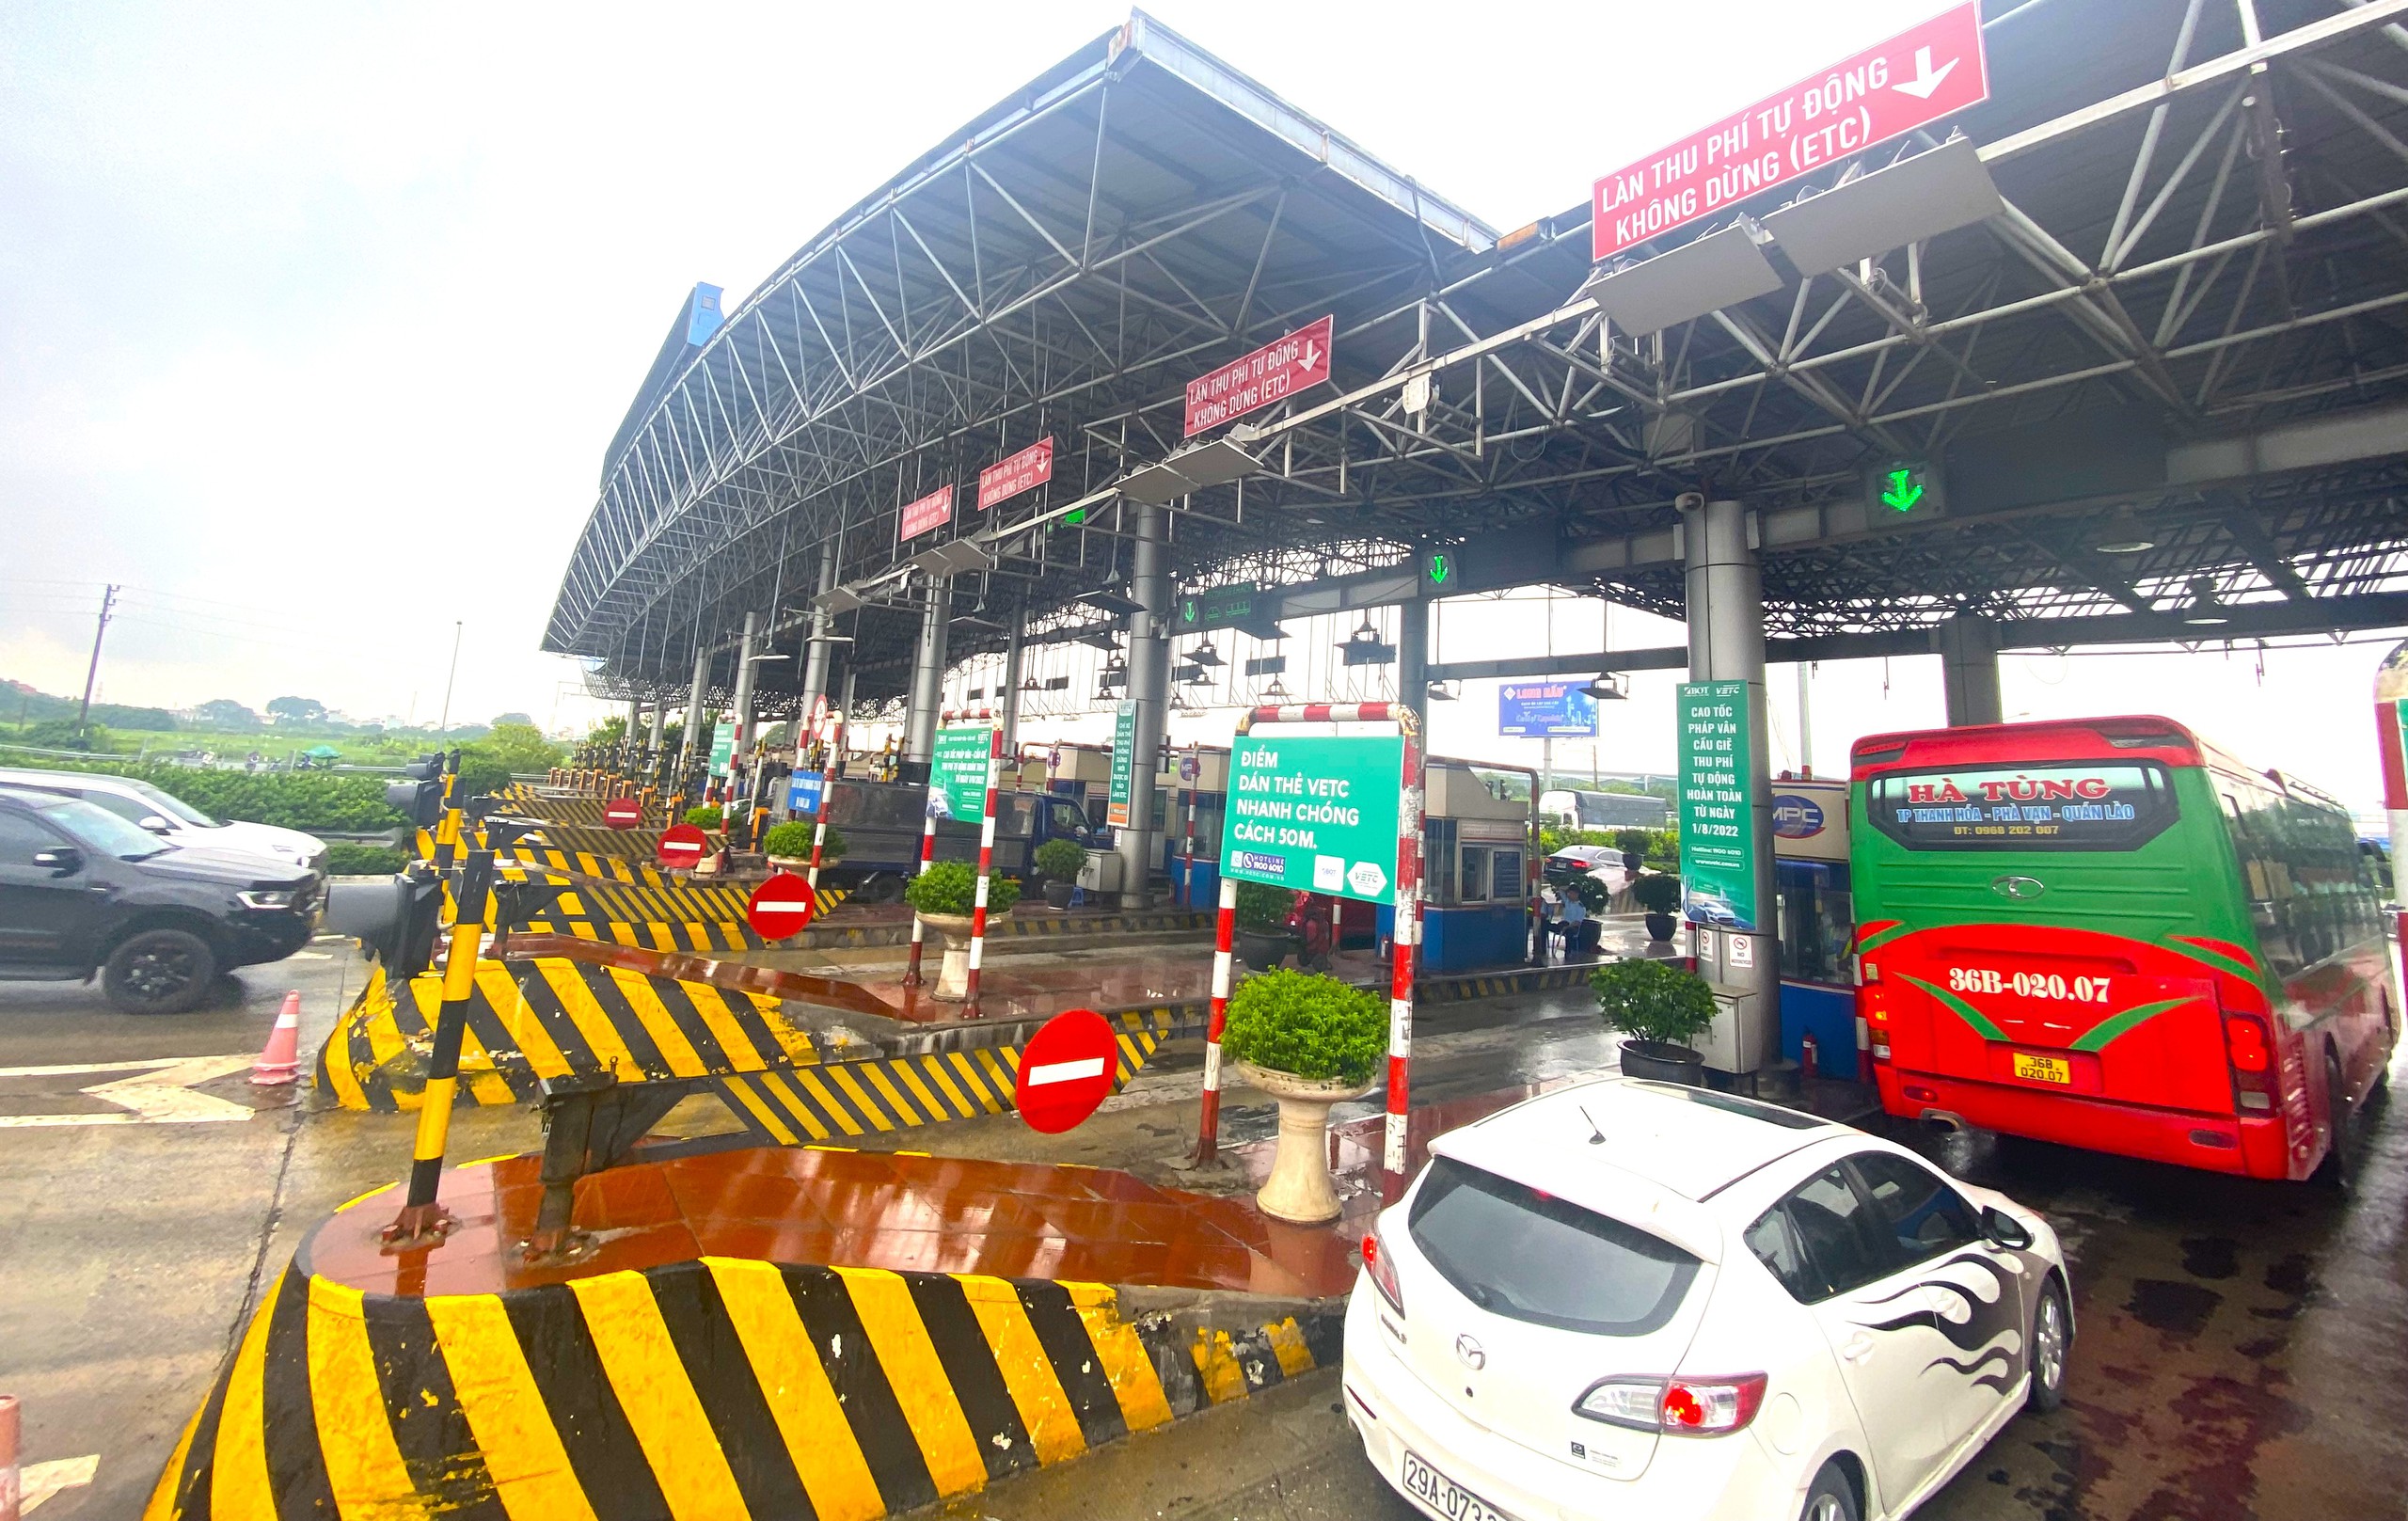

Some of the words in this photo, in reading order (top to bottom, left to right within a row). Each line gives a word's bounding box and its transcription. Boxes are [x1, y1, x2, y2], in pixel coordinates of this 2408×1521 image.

[1602, 169, 1644, 214] LÀN
[1651, 145, 1699, 190] THU
[1707, 112, 1750, 163] PHÍ
[1757, 100, 1795, 138] TỰ
[1802, 56, 1889, 121] ĐỘNG
[1615, 190, 1697, 246] KHÔNG
[1706, 151, 1780, 208] DỪNG
[1789, 105, 1872, 172] (ETC)
[1190, 383, 1208, 405] LÀN
[1211, 372, 1229, 398] THU
[1231, 358, 1249, 388] PHÍ
[1252, 354, 1266, 380] TỰ
[1268, 340, 1299, 372] ĐỘNG
[1194, 399, 1227, 429] KHÔNG
[1229, 387, 1259, 415] DỪNG
[1260, 368, 1291, 403] (ETC)
[1716, 687, 1740, 695] VETC
[1691, 706, 1711, 718] CAO
[1713, 704, 1733, 718] TỐC
[1687, 721, 1715, 734] PHÁP
[1718, 721, 1736, 734] VÂN
[1241, 744, 1278, 768] ĐIỂM
[1693, 756, 1713, 768] THU
[1716, 754, 1734, 768] PHÍ
[1239, 771, 1270, 792] DÁN
[1275, 771, 1303, 795] THẺ
[1307, 778, 1350, 798] VETC
[1692, 772, 1705, 786] TỰ
[1707, 771, 1735, 786] ĐỘNG
[1908, 777, 1969, 803] HÀ
[1979, 774, 2111, 802] TÙNG
[1687, 786, 1714, 801] HOÀN
[1716, 788, 1742, 802] TOÀN
[1237, 799, 1291, 820] NHANH
[1296, 800, 1359, 826] CHÓNG
[1694, 804, 1707, 817] TỪ
[1709, 805, 1735, 819] NGÀY
[1896, 808, 1911, 823] TP
[1913, 808, 1955, 823] THANH
[1955, 803, 1984, 822] HÓA
[2021, 806, 2052, 824] VẠN
[2104, 800, 2135, 821] LÀO
[1234, 819, 1275, 844] CÁCH
[1278, 828, 1318, 848] 50M.
[1692, 823, 1739, 837] 1/8/2022
[1254, 855, 1285, 865] HOTLINE
[1254, 861, 1268, 870] 1900
[1268, 863, 1284, 873] 6010
[1949, 967, 2112, 1004] 36B-020.07
[2029, 1056, 2053, 1069] 36B
[2020, 1067, 2064, 1082] 020.07
[1407, 1460, 1497, 1521] 29A-073
